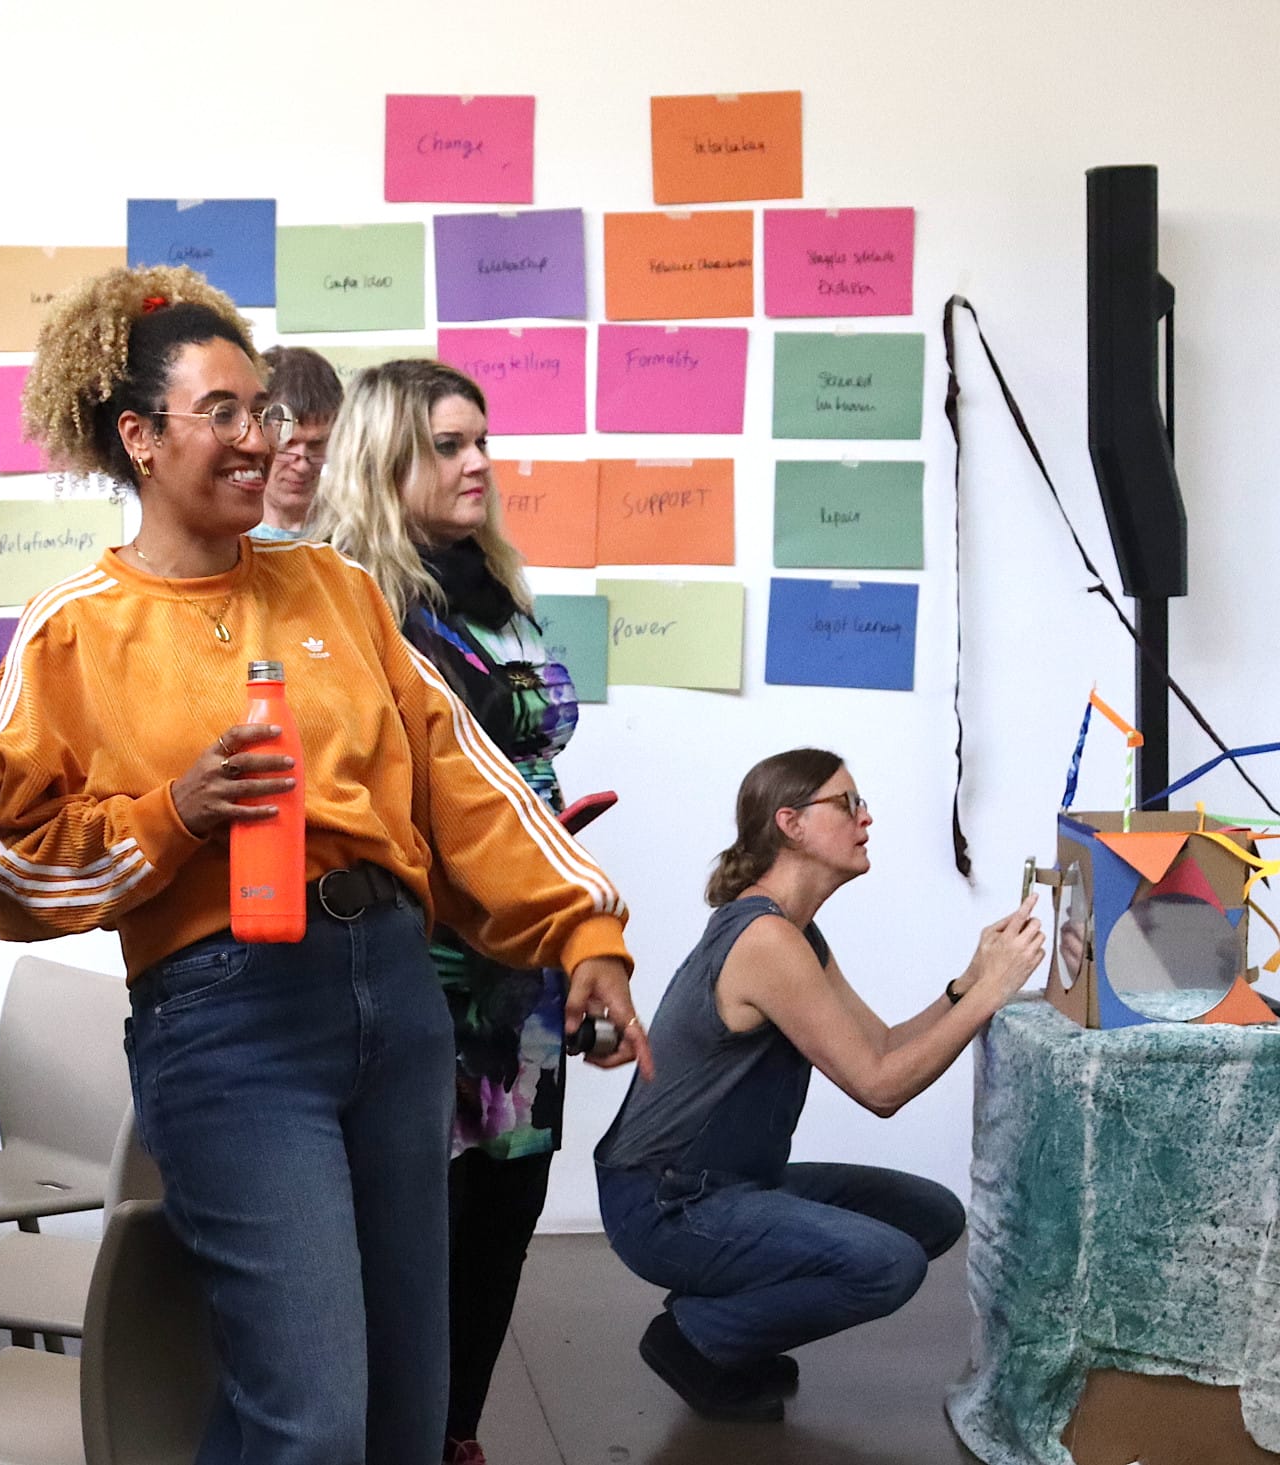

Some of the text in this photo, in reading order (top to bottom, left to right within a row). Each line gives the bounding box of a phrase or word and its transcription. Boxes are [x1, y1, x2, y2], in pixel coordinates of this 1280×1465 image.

[417, 135, 483, 159] Change
[623, 487, 712, 520] SUPPORT
[0, 528, 96, 556] Relationships
[612, 618, 678, 646] Power
